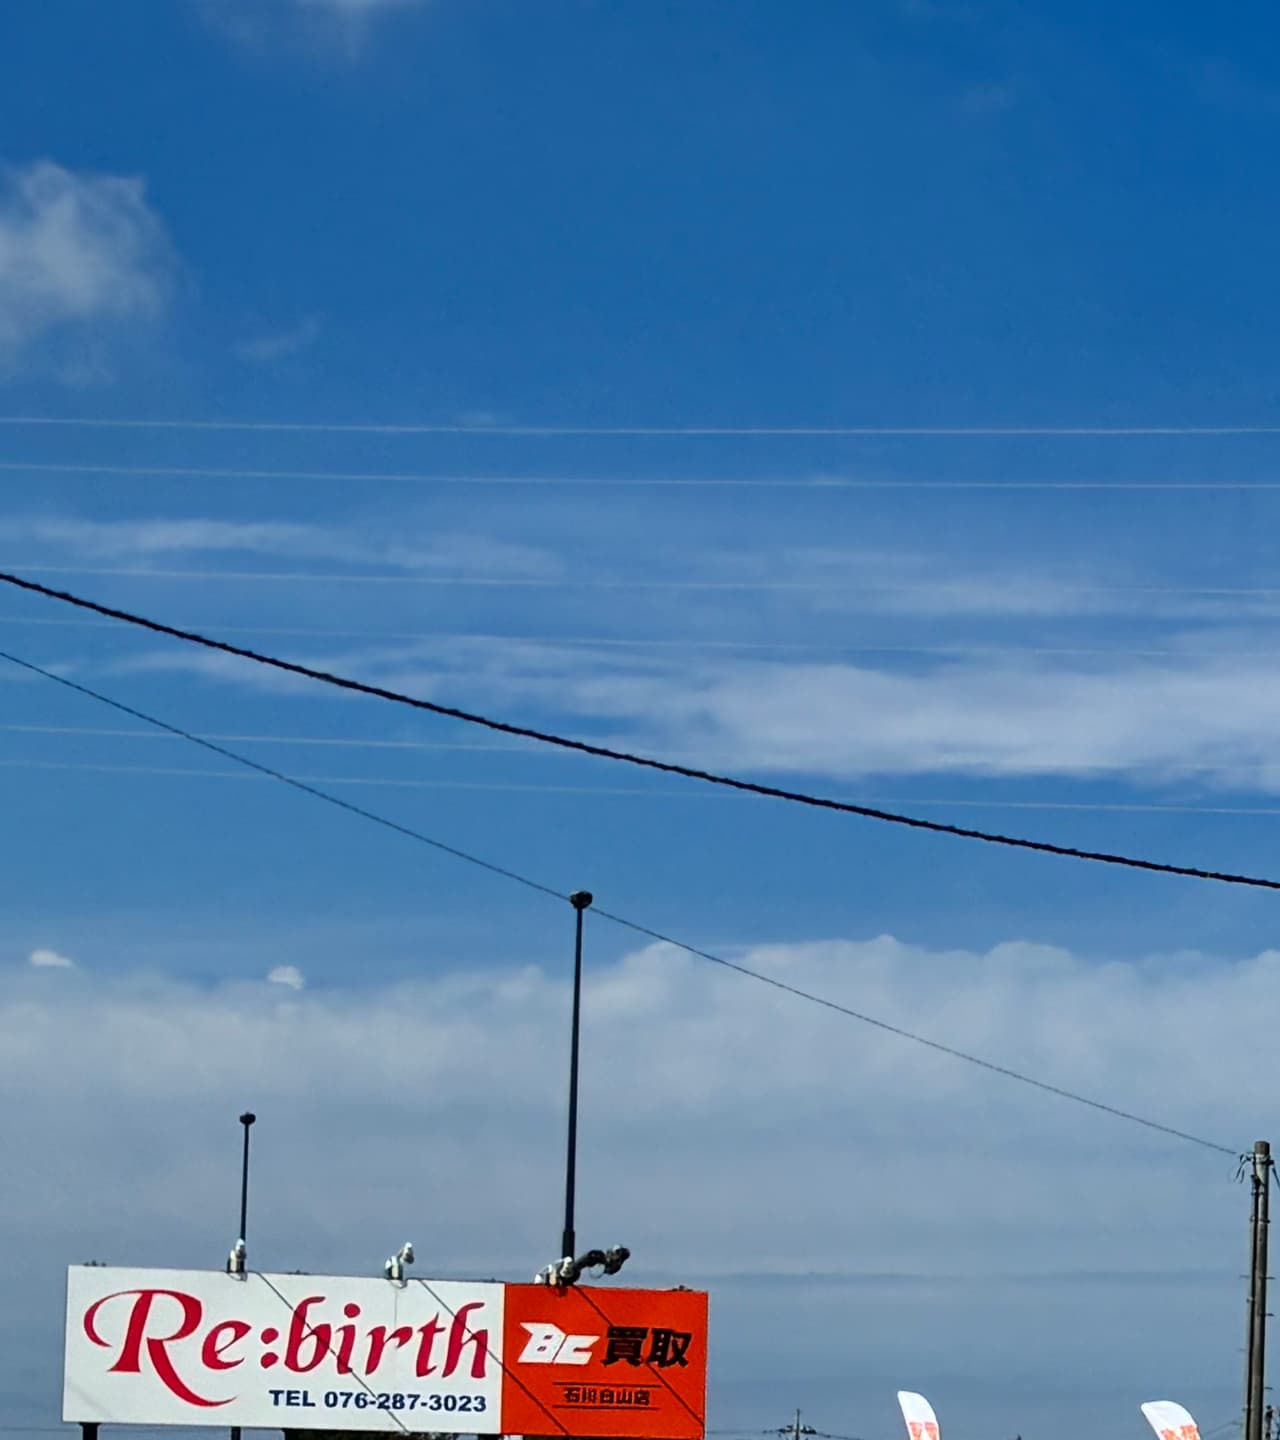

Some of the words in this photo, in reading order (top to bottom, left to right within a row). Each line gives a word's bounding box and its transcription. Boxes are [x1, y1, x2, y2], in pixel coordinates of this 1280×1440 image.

[83, 1288, 488, 1408] Re:birth
[602, 1325, 692, 1368] 買取
[268, 1388, 317, 1408] TEL
[324, 1390, 488, 1413] 076-287-3023
